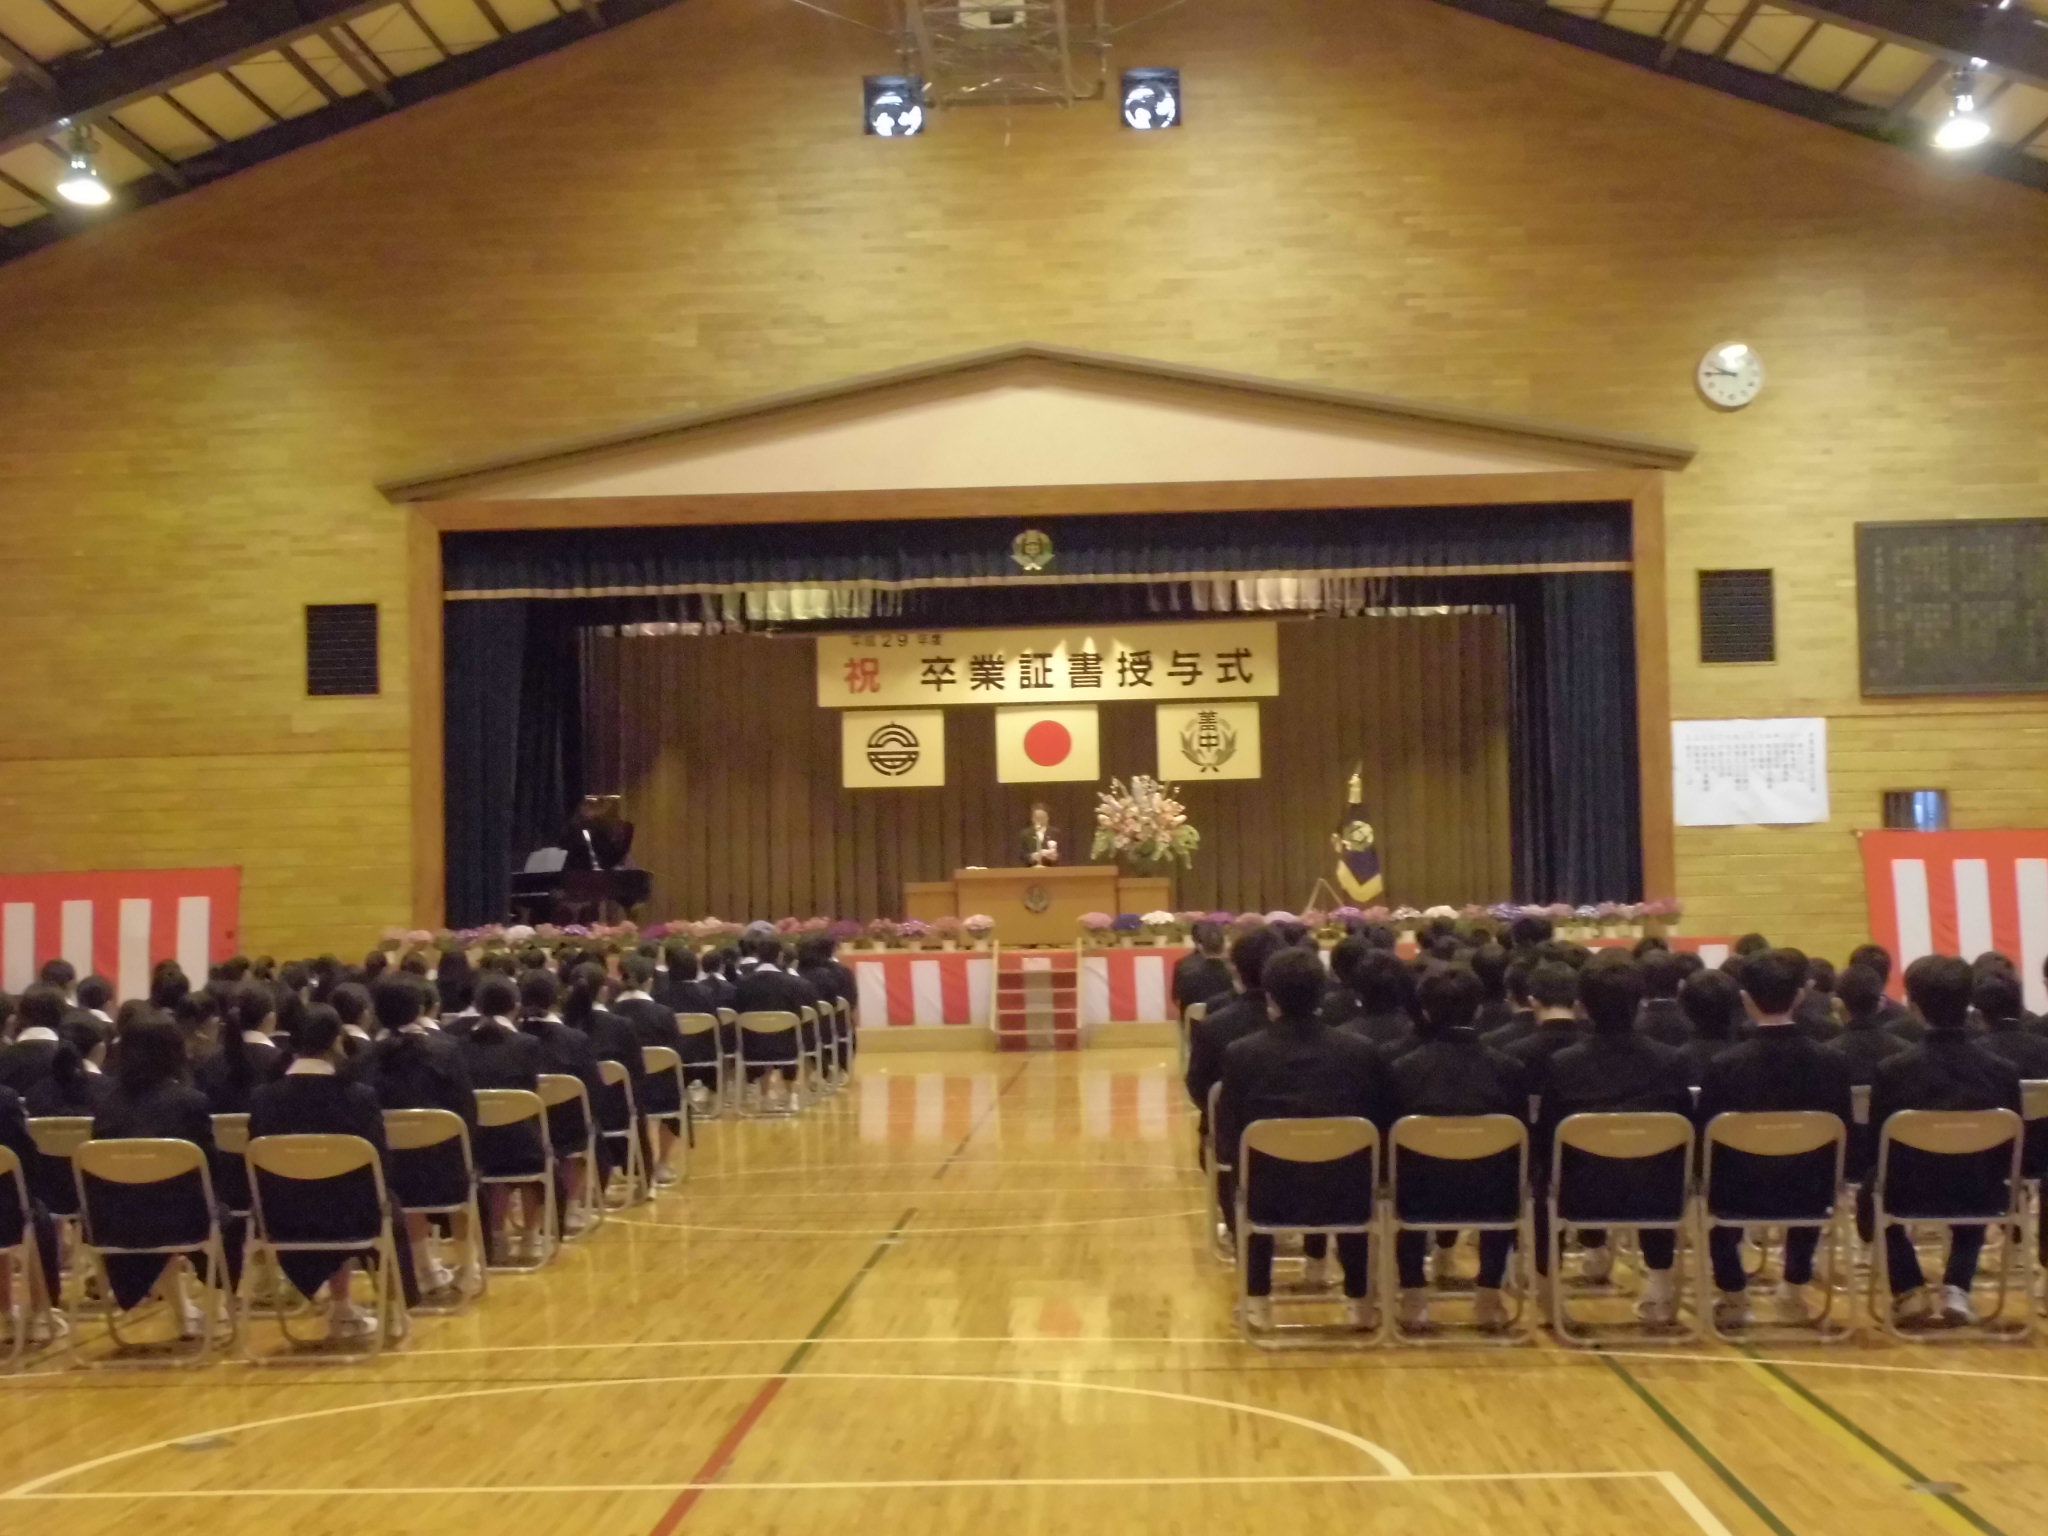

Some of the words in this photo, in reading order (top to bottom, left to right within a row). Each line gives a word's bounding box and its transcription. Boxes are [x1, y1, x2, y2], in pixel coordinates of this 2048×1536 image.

[844, 657, 880, 694] 祝
[920, 648, 1253, 692] 卒業証書授与式
